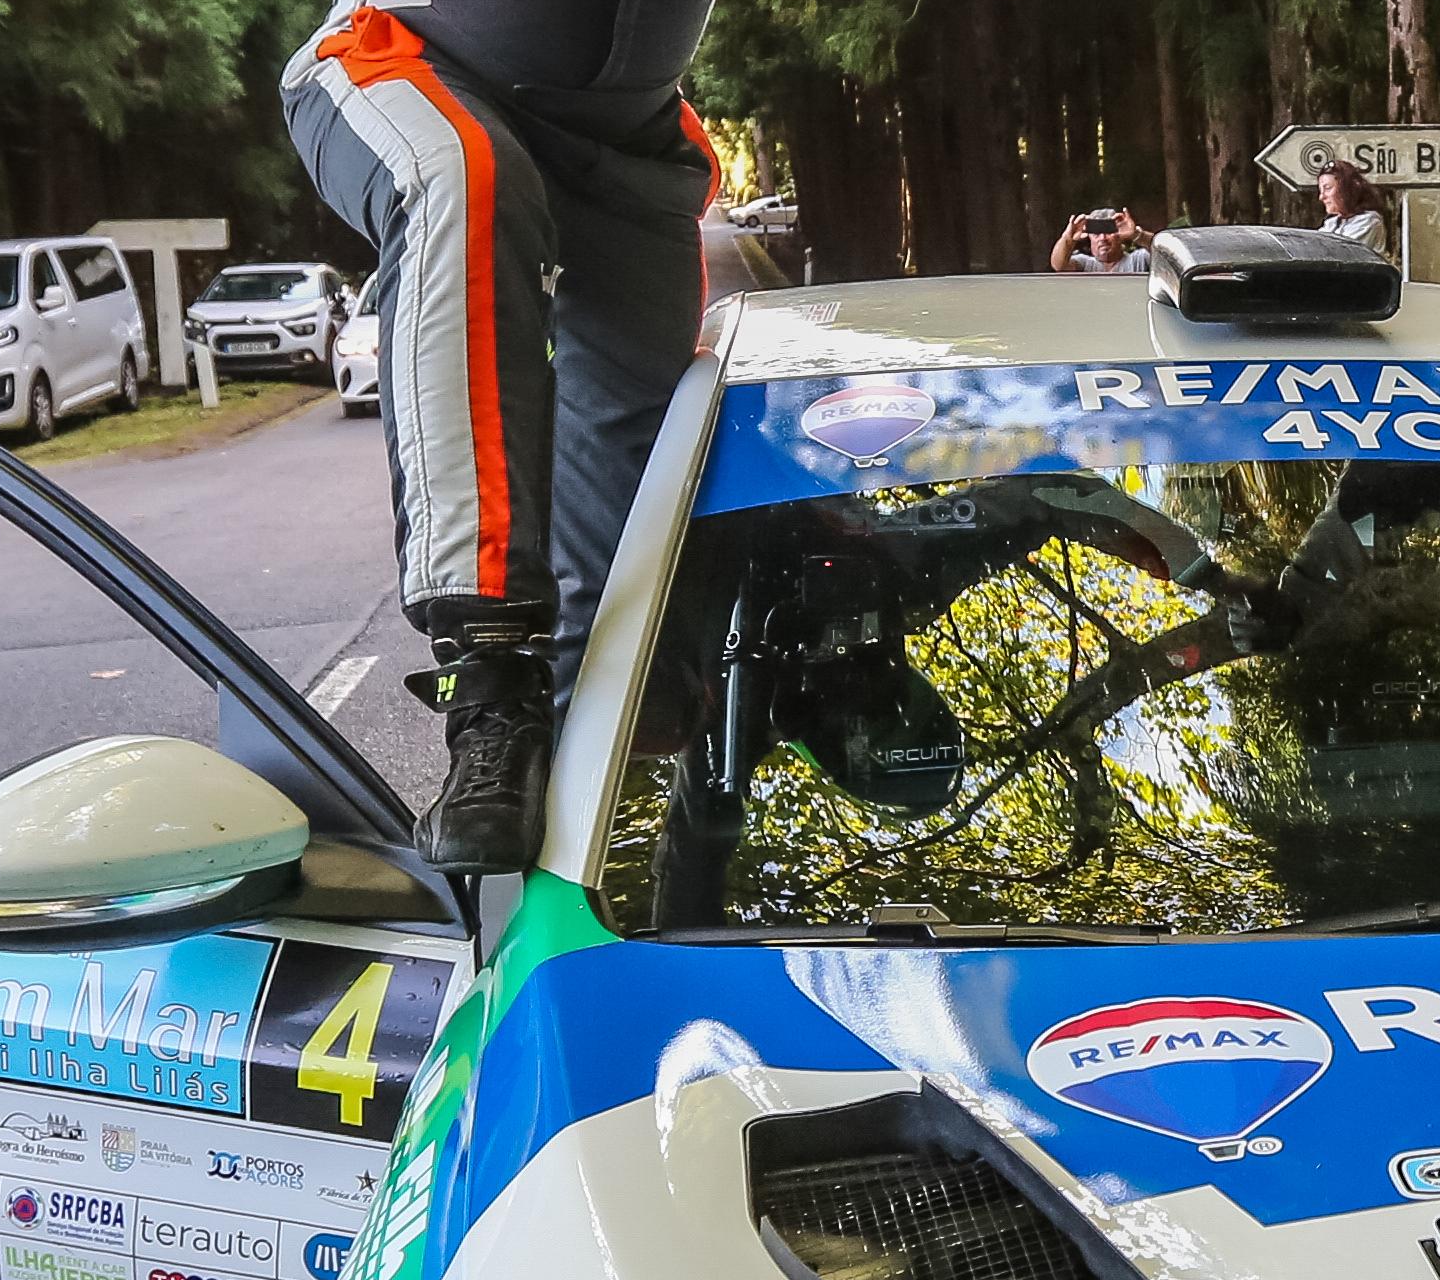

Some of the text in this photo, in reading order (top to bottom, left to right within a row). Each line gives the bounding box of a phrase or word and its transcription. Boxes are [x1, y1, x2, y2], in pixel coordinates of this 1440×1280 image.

[821, 401, 919, 420] RE/MAX
[68, 960, 240, 1068] Mar
[297, 960, 389, 1126] 4
[1069, 1029, 1290, 1069] RE/MAX
[30, 1049, 109, 1087] Ilha
[130, 1063, 230, 1104] Lilás
[22, 1143, 34, 1153] do
[245, 1156, 304, 1178] PORTOS
[247, 1169, 304, 1191] AÇORES
[49, 1192, 124, 1229] SRPCBA
[140, 1215, 273, 1261] terauto
